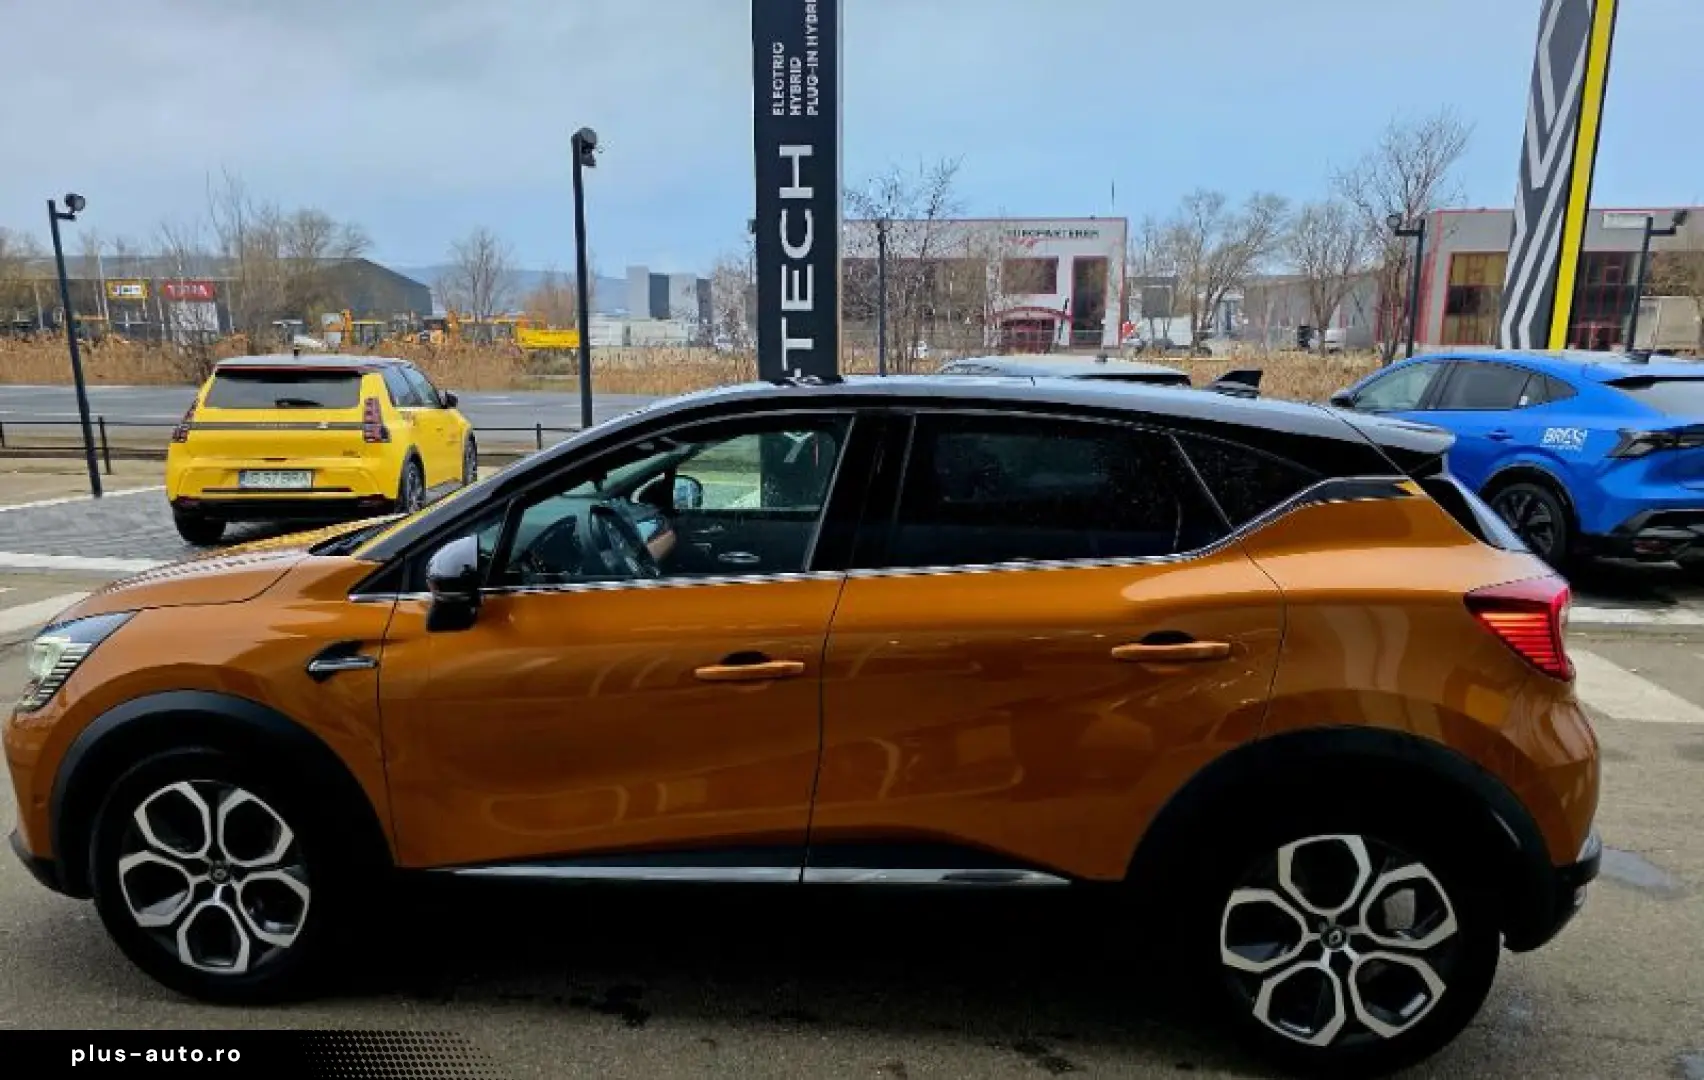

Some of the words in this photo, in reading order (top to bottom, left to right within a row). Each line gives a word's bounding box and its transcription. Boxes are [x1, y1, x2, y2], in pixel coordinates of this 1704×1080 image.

[804, 0, 819, 46] HYBRI
[772, 42, 785, 116] ELECTRIC
[789, 56, 802, 116] HYBRID
[806, 50, 819, 116] PLUG-IN
